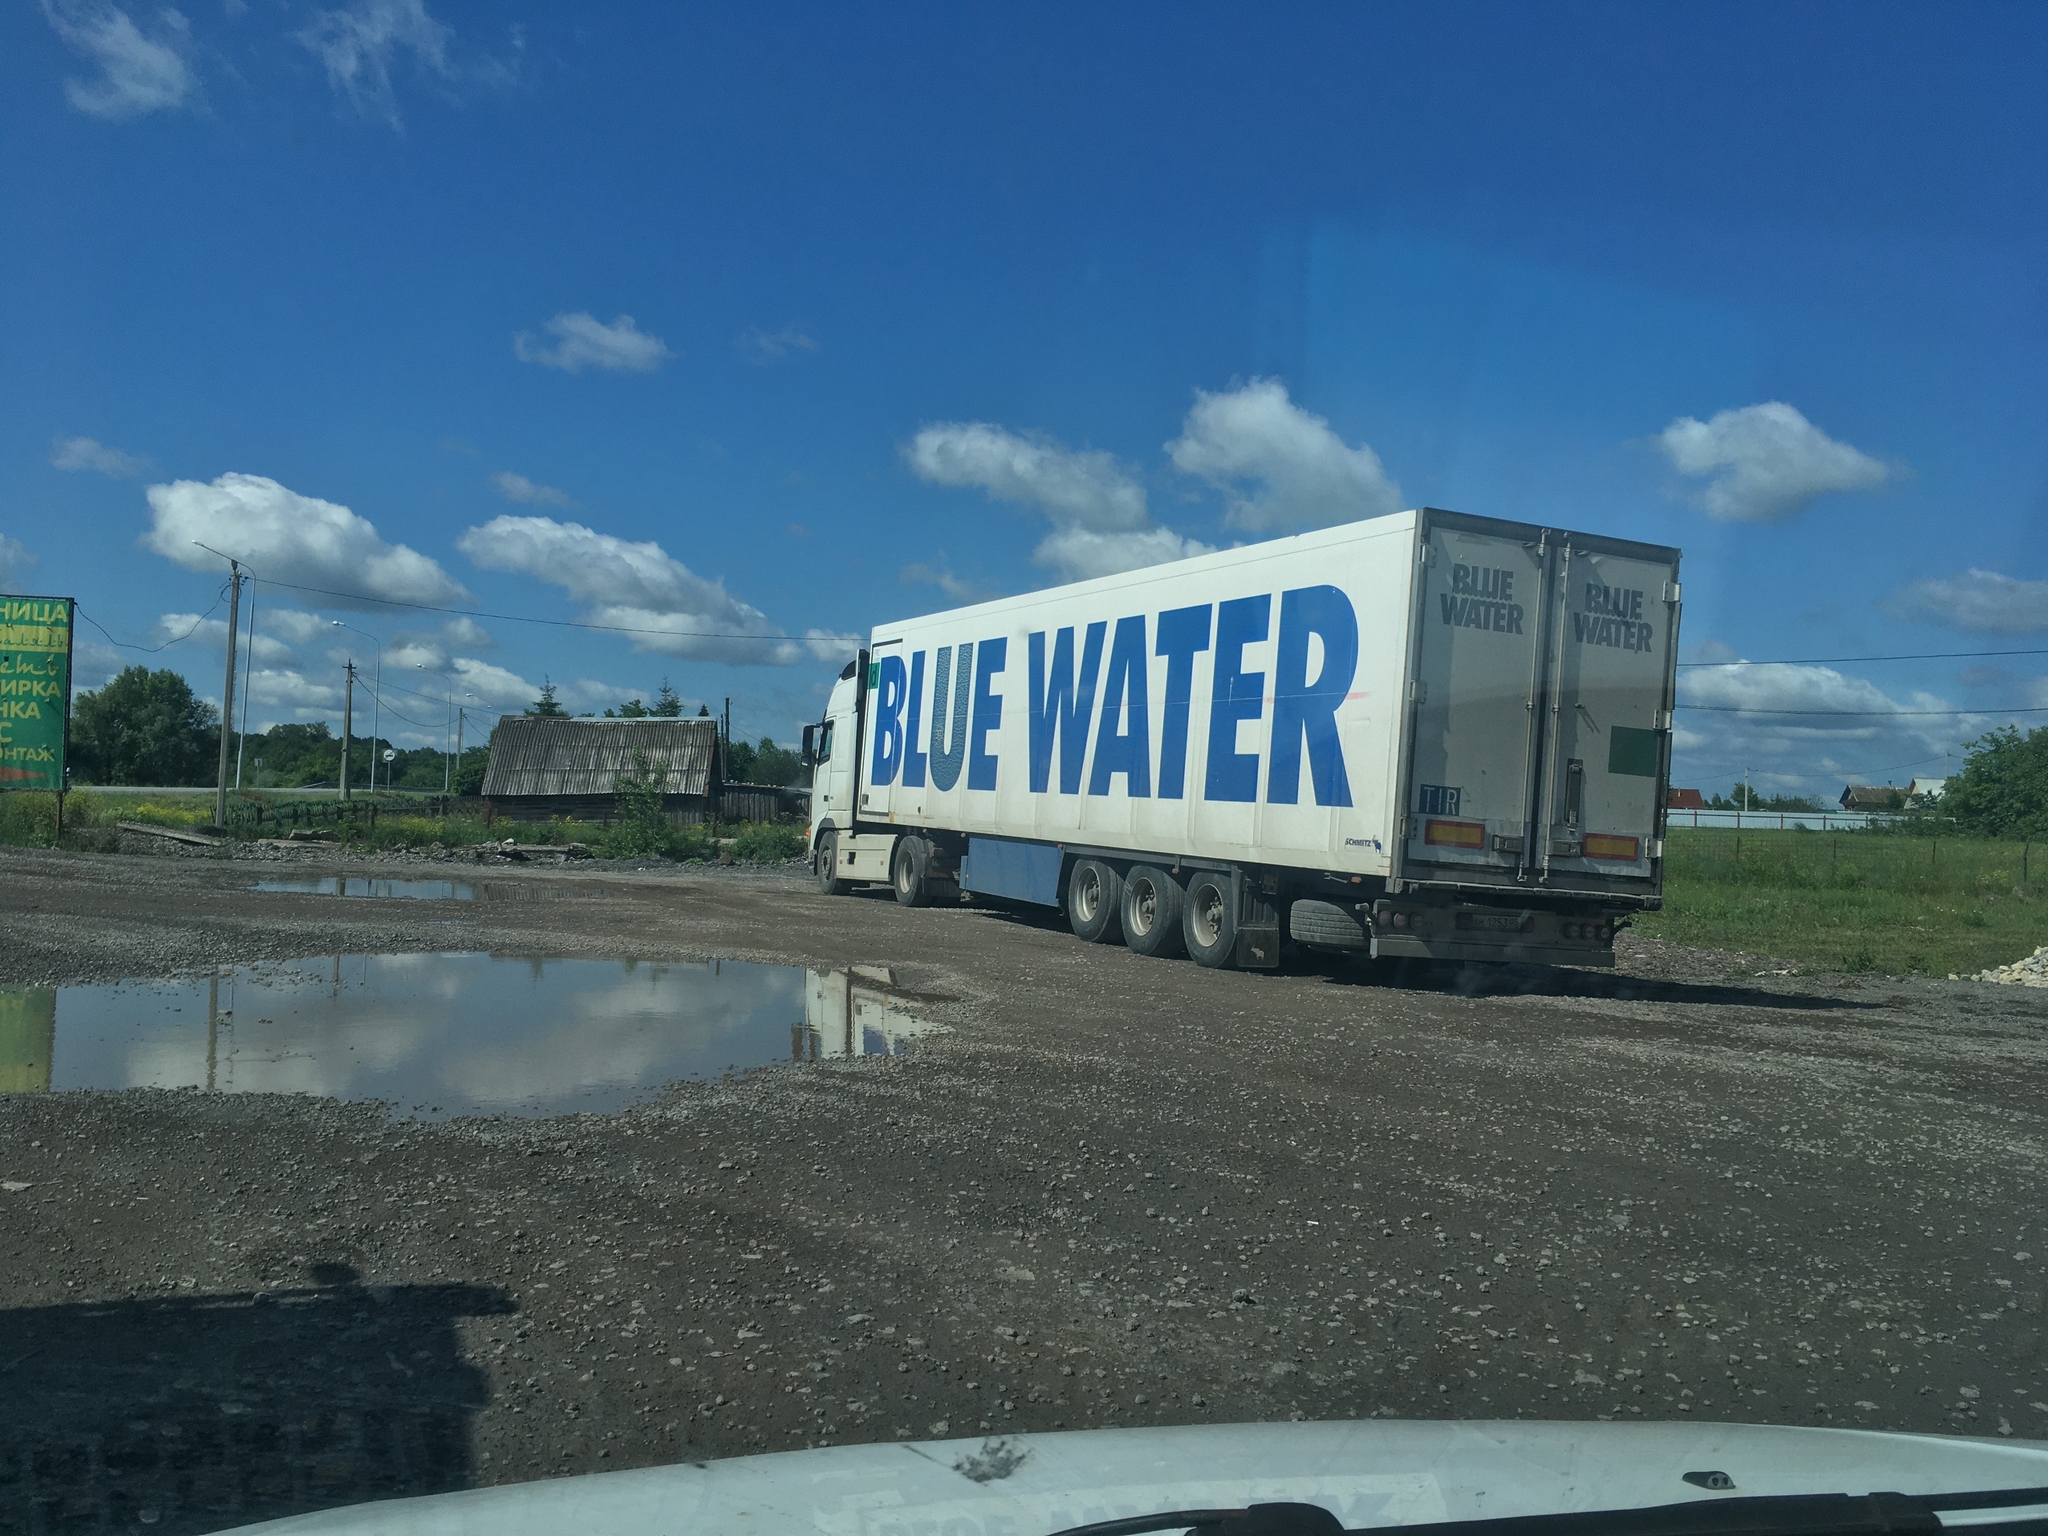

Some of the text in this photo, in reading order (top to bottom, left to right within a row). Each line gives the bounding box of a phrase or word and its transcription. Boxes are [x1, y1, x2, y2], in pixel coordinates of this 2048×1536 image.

[1452, 563, 1514, 601] BLUE
[1440, 593, 1524, 635] WATER
[1585, 583, 1643, 620] BLUE
[1573, 612, 1653, 653] WATER
[871, 584, 1359, 808] BLUE WATER
[1423, 786, 1457, 815] TIR
[1345, 837, 1372, 847] SCHMITZ
